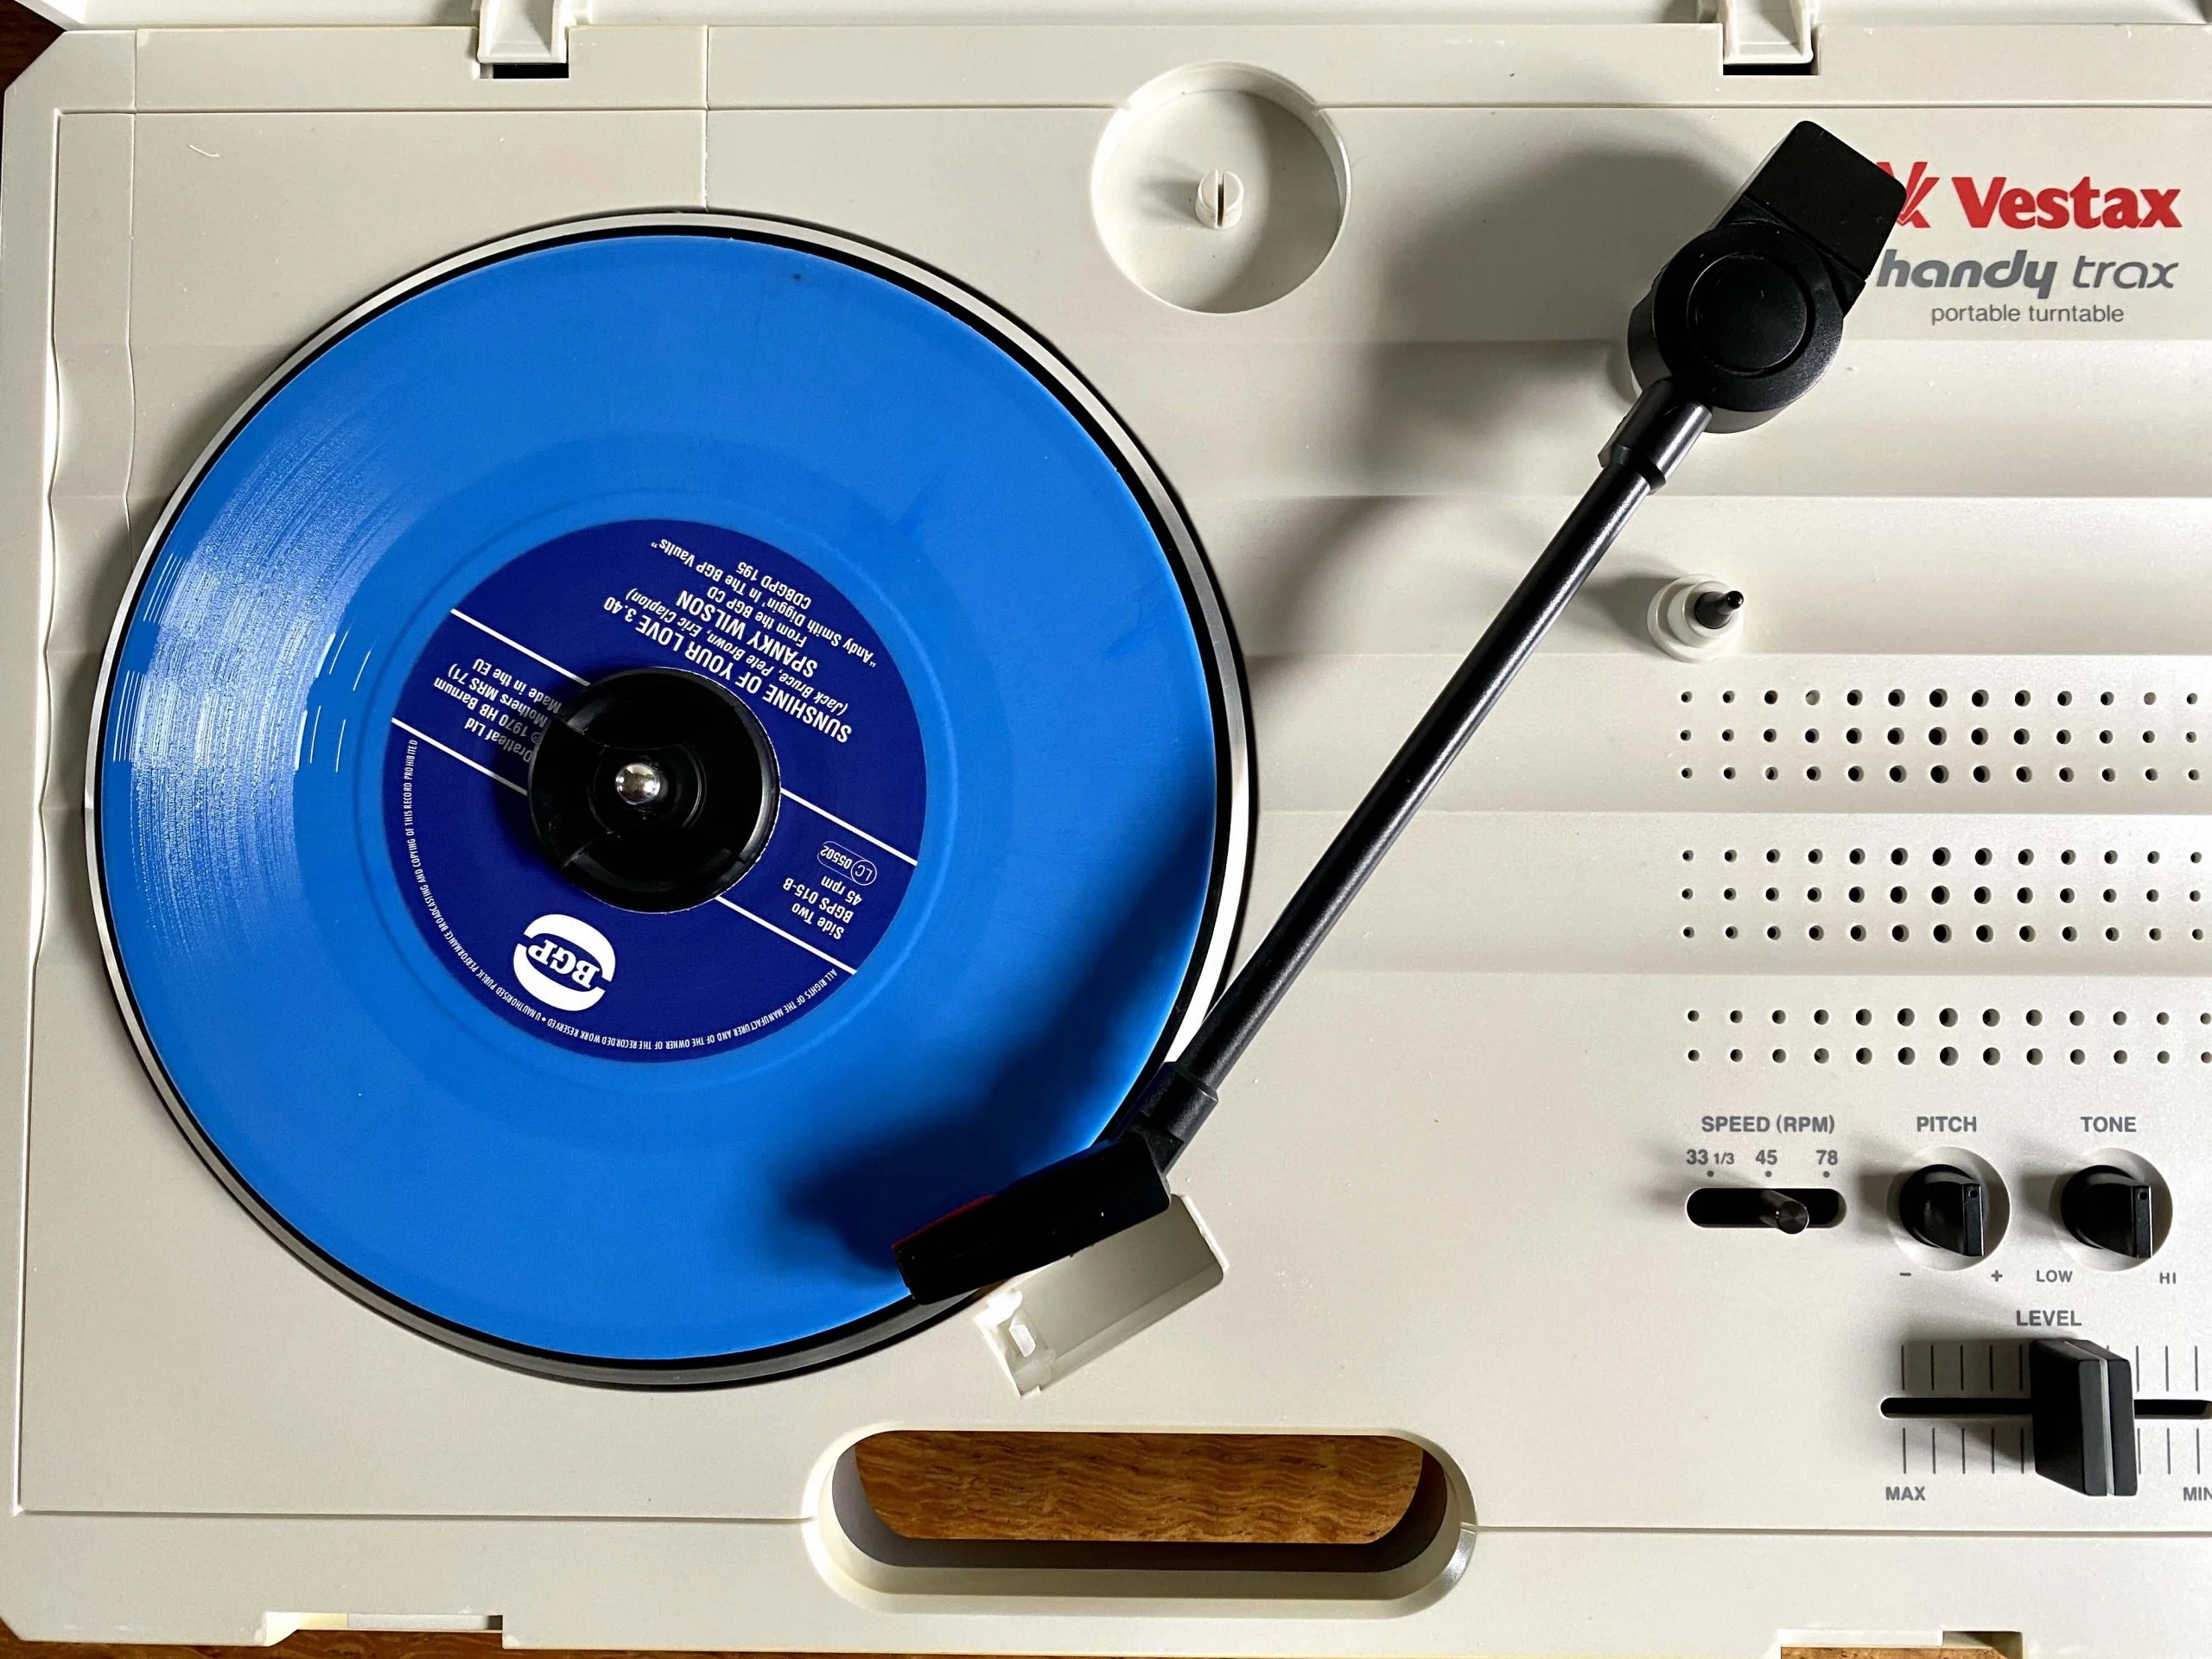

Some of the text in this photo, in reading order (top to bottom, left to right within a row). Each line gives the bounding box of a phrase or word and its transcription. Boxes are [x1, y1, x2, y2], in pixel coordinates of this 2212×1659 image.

[1951, 176, 2183, 229] Vestax
[1876, 249, 2179, 300] handy trax
[1932, 304, 2124, 326] portable turntable
[735, 562, 811, 609] CDBGPD 195
[651, 538, 875, 667] “Andy Smith Diggin’ In The BGP Vaults”
[706, 586, 807, 647] From the BGP CD
[675, 589, 817, 677] SPANKY WILSON
[625, 588, 848, 715] (Jack Bruce, Pete Brown, Eric Clapton)
[448, 663, 468, 684] 71)
[603, 596, 851, 742] SUNSHINE OF YOUR LOVE 3.40
[433, 677, 478, 709] Barnum
[468, 677, 499, 701] MRS
[472, 658, 562, 713] Made in the EU
[479, 703, 499, 721] HB
[498, 714, 527, 736] 1970
[464, 717, 535, 762] Dratleaf Ltd
[403, 782, 411, 809] RECORD
[404, 810, 412, 826] THIS
[406, 838, 421, 867] COPYING
[820, 845, 873, 880] LC 05502
[414, 868, 426, 882] AND
[782, 877, 854, 923] BGPS 015-B
[820, 875, 862, 906] 45 rpm
[419, 884, 448, 931] BROADCASTING
[791, 902, 844, 939] Side Two
[443, 930, 479, 972] PERFORMANCE
[528, 939, 602, 988] BGP
[475, 969, 497, 989] PUBLIC
[823, 968, 837, 981] ALL
[804, 978, 827, 999] RIGHTS
[782, 1001, 797, 1013] THE
[796, 995, 805, 1005] OF
[546, 1018, 579, 1037] RESERVED
[732, 1007, 784, 1036] MANUFACTURER
[579, 1030, 600, 1043] WORK
[601, 1036, 637, 1048] RECORDED
[638, 1040, 652, 1049] THE
[654, 1040, 663, 1049] OF
[664, 1039, 690, 1049] OWNER
[690, 1036, 704, 1046] THE
[706, 1034, 715, 1044] OF
[716, 1029, 731, 1041] AND
[1701, 1115, 1834, 1134] SPEED (RPM)
[1916, 1116, 1977, 1133] PITCH
[2080, 1116, 2137, 1133] TONE
[1686, 1149, 1734, 1166] 33 1/3
[1755, 1149, 1777, 1165] 45
[1815, 1150, 1838, 1165] 78
[2037, 1269, 2073, 1282] LOW
[2159, 1272, 2176, 1284] HI
[2016, 1309, 2082, 1327] LEVEL
[1885, 1486, 1925, 1501] MAX
